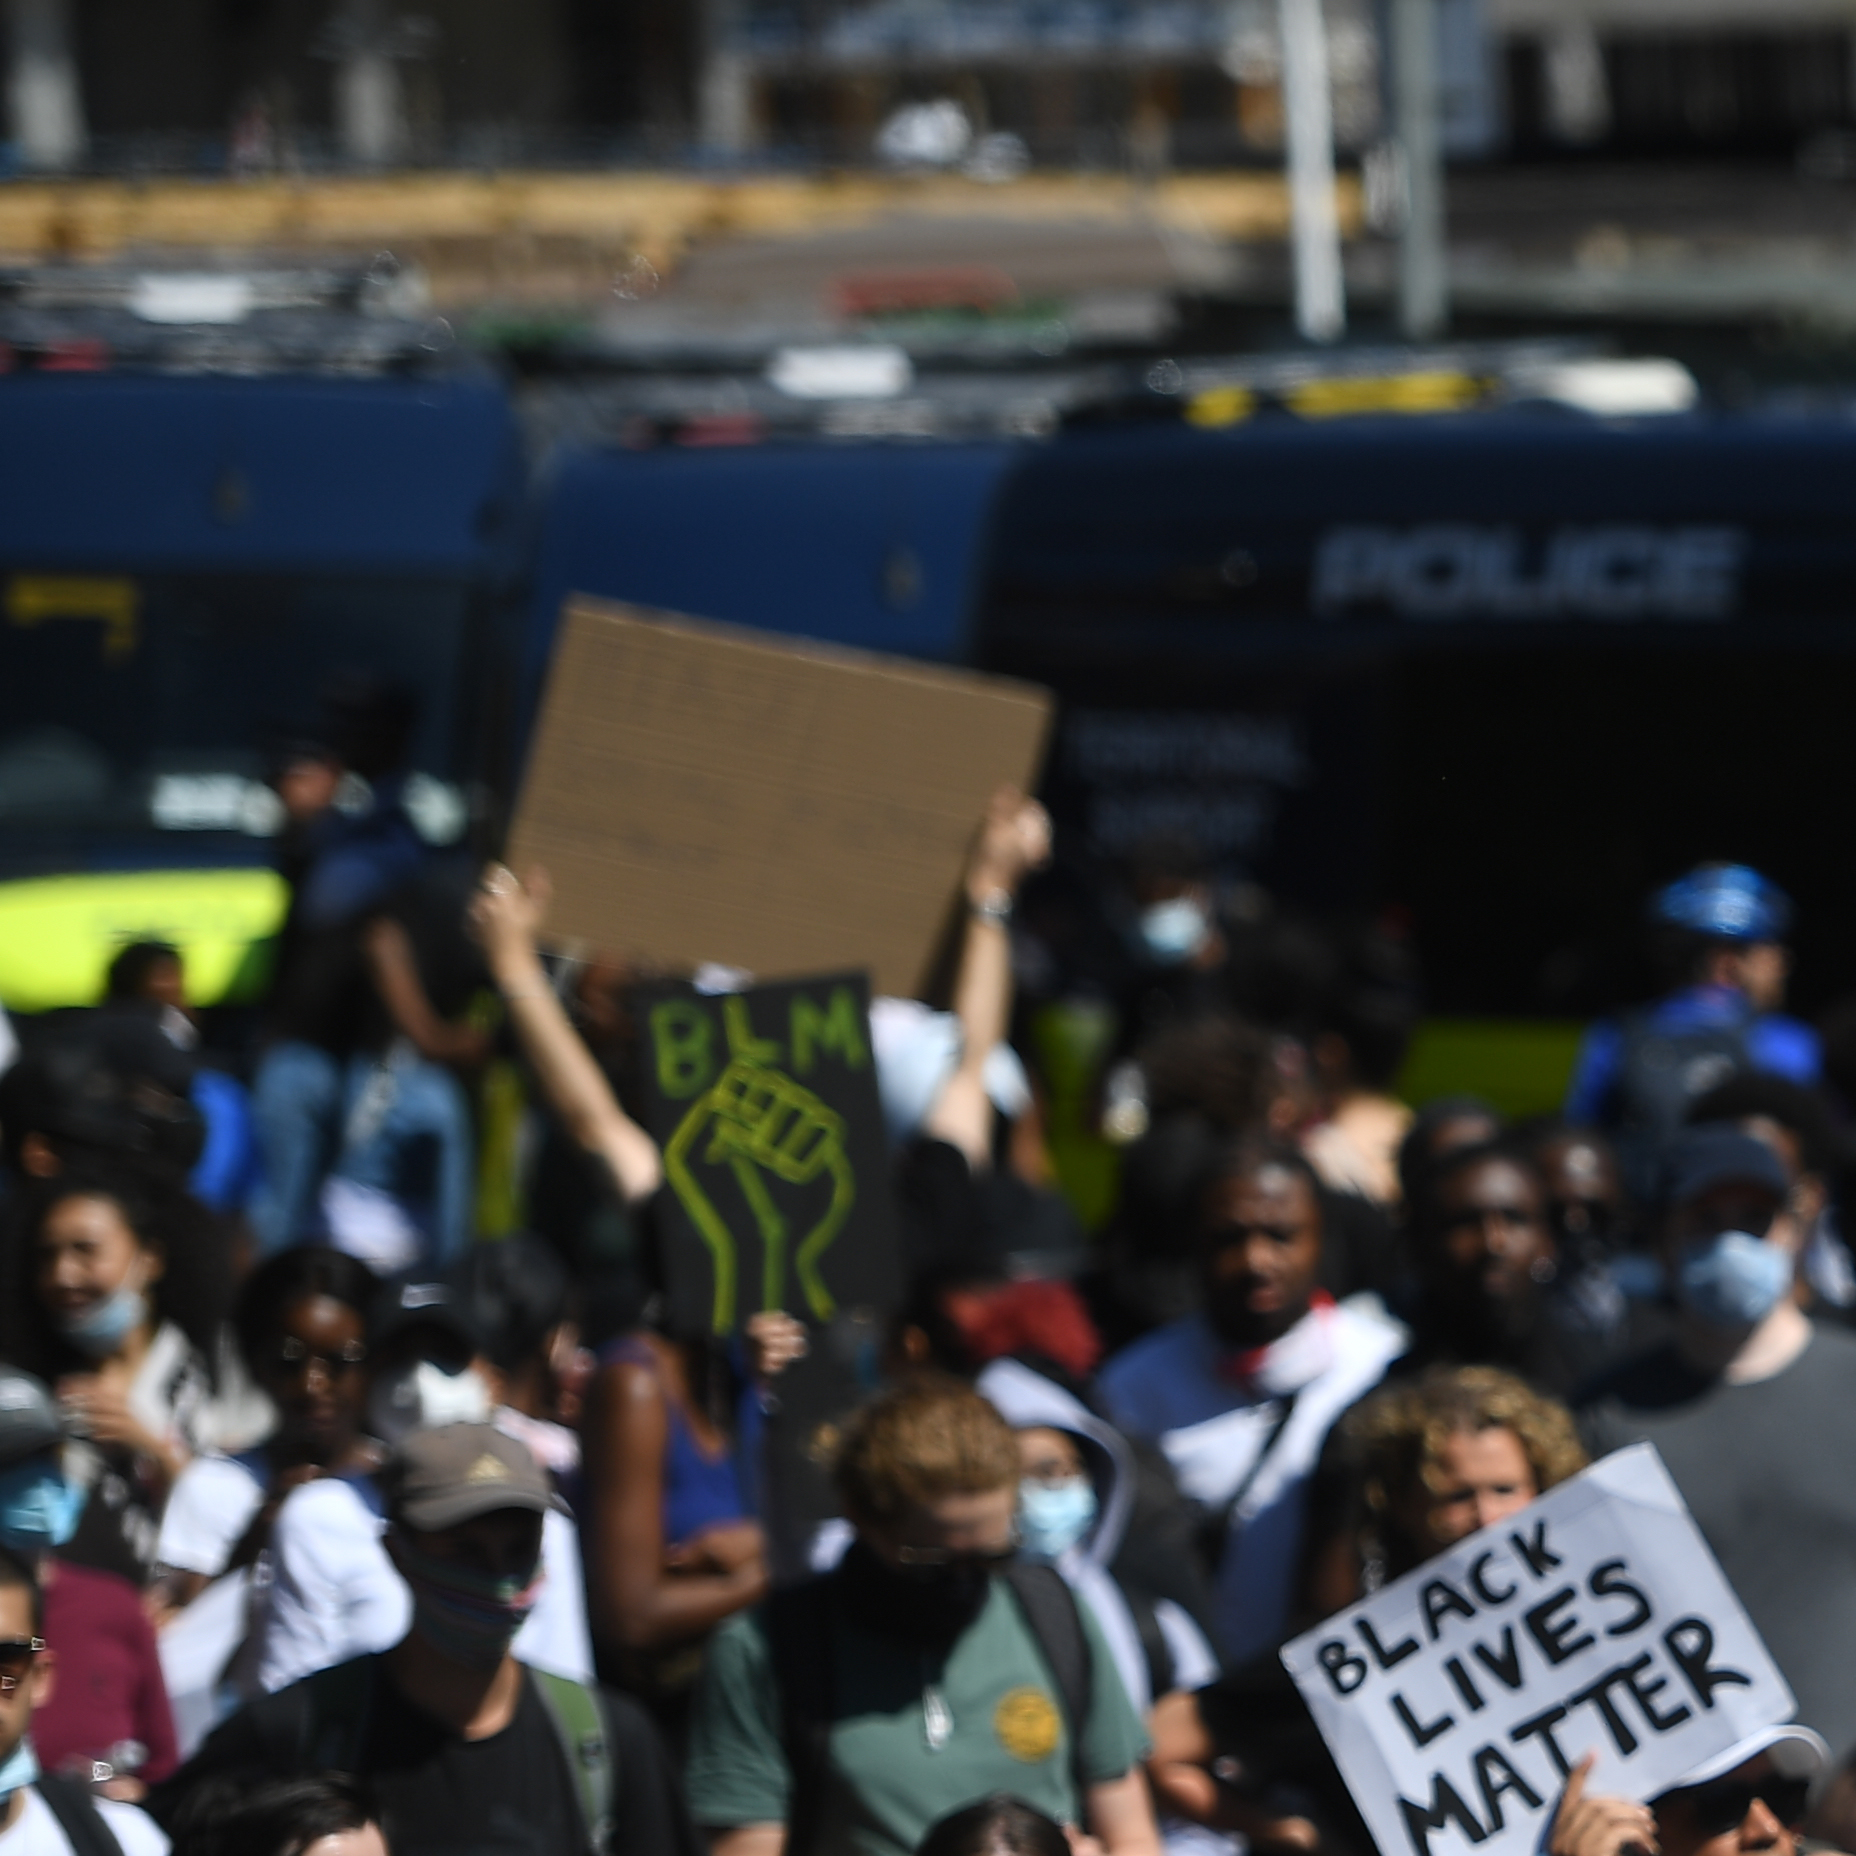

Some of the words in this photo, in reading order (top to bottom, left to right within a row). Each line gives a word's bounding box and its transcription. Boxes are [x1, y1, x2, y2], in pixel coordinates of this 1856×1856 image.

[1315, 523, 1745, 620] POLICE
[650, 987, 868, 1098] BLM
[1317, 1519, 1562, 1696] BLACK
[1391, 1558, 1652, 1748] LIVES
